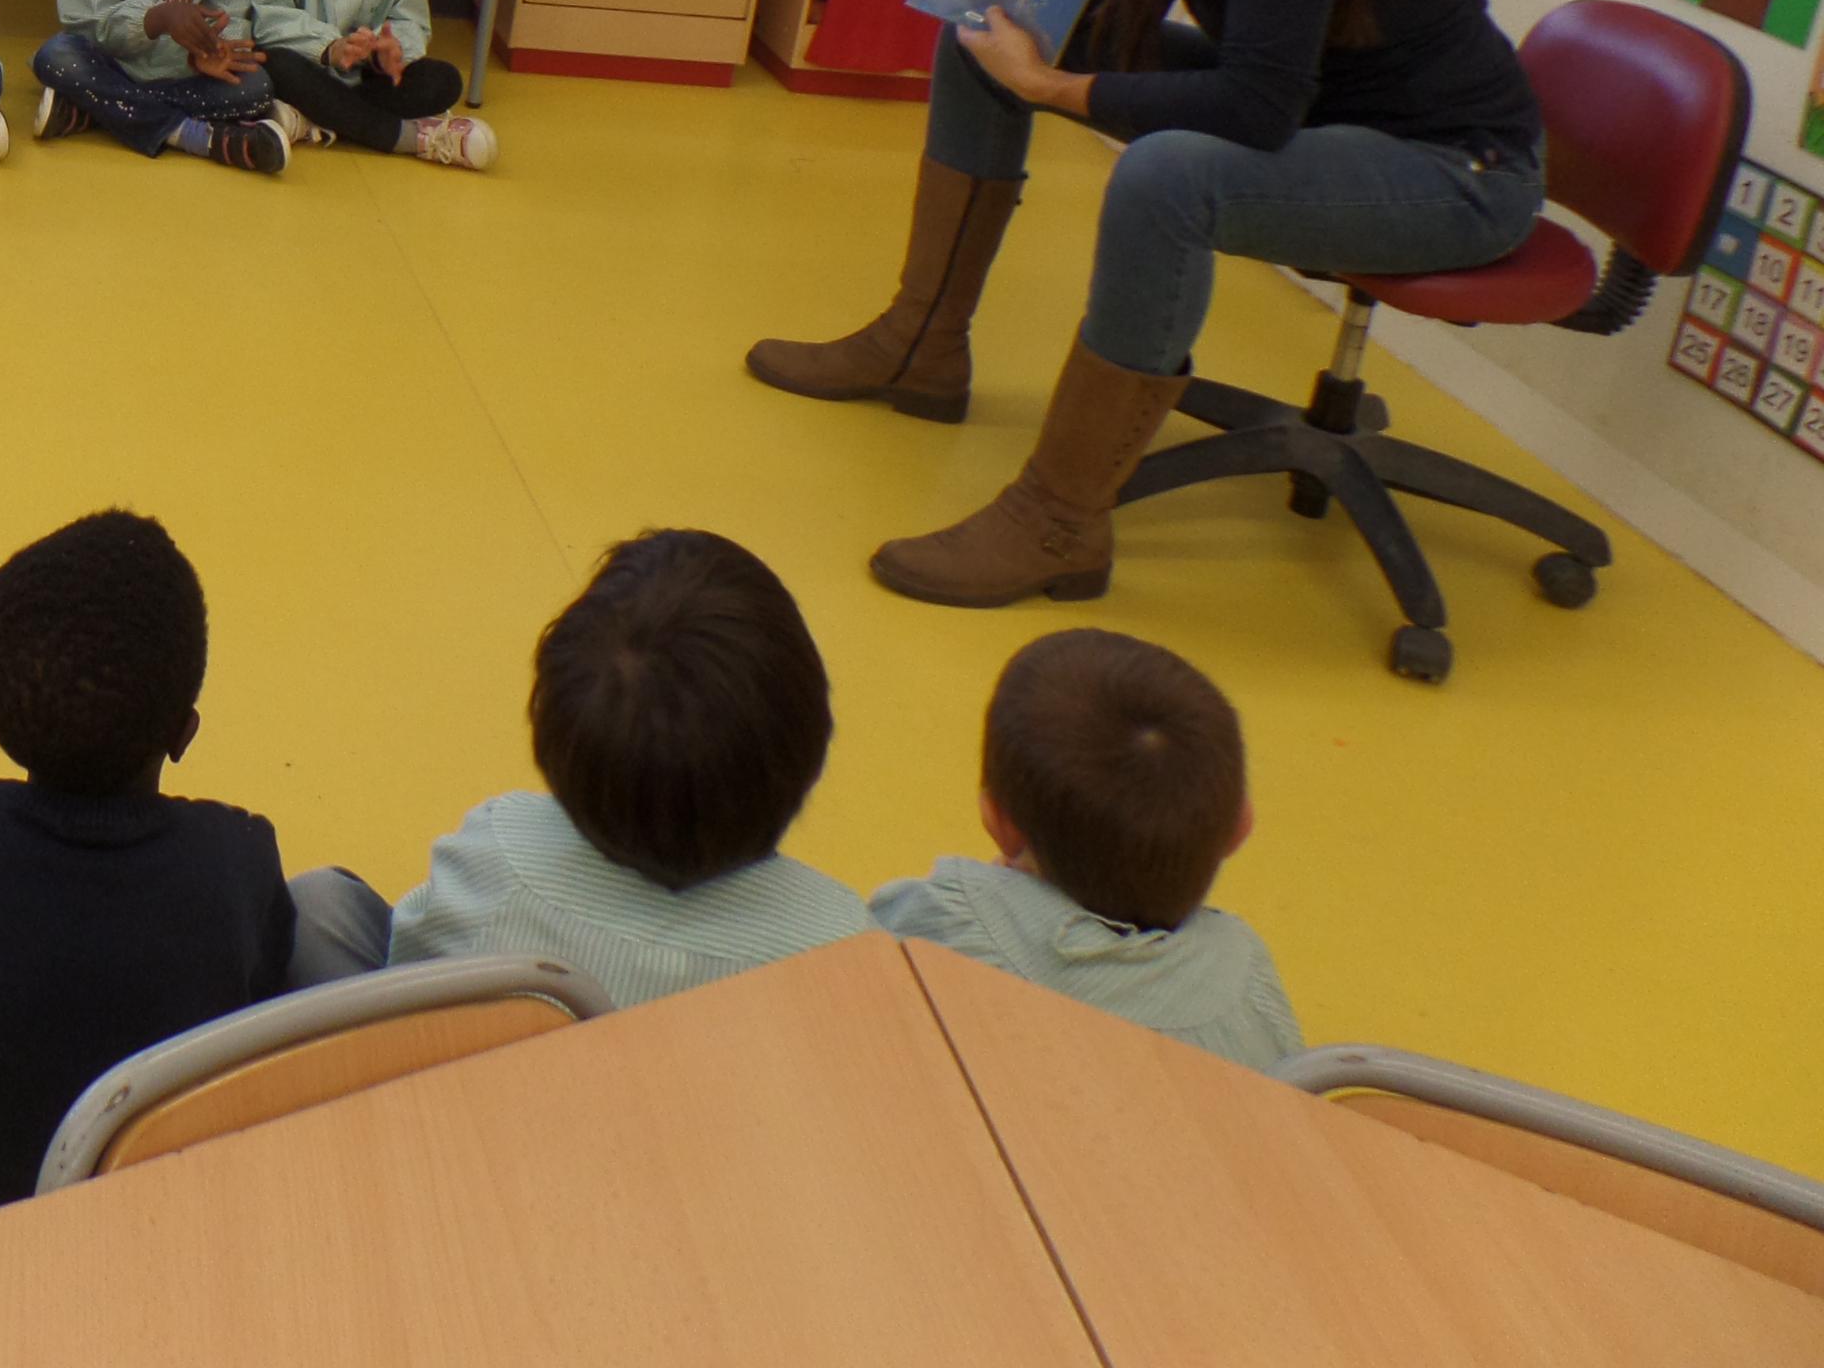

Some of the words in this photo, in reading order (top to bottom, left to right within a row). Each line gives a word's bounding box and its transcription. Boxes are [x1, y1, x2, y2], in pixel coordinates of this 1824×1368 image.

[1741, 179, 1753, 206] 1
[1778, 197, 1796, 227] 2
[1758, 253, 1784, 284] 10
[1701, 283, 1729, 312] 17
[1784, 334, 1809, 364] 19
[1680, 333, 1713, 365] 25
[1761, 380, 1794, 412] 27
